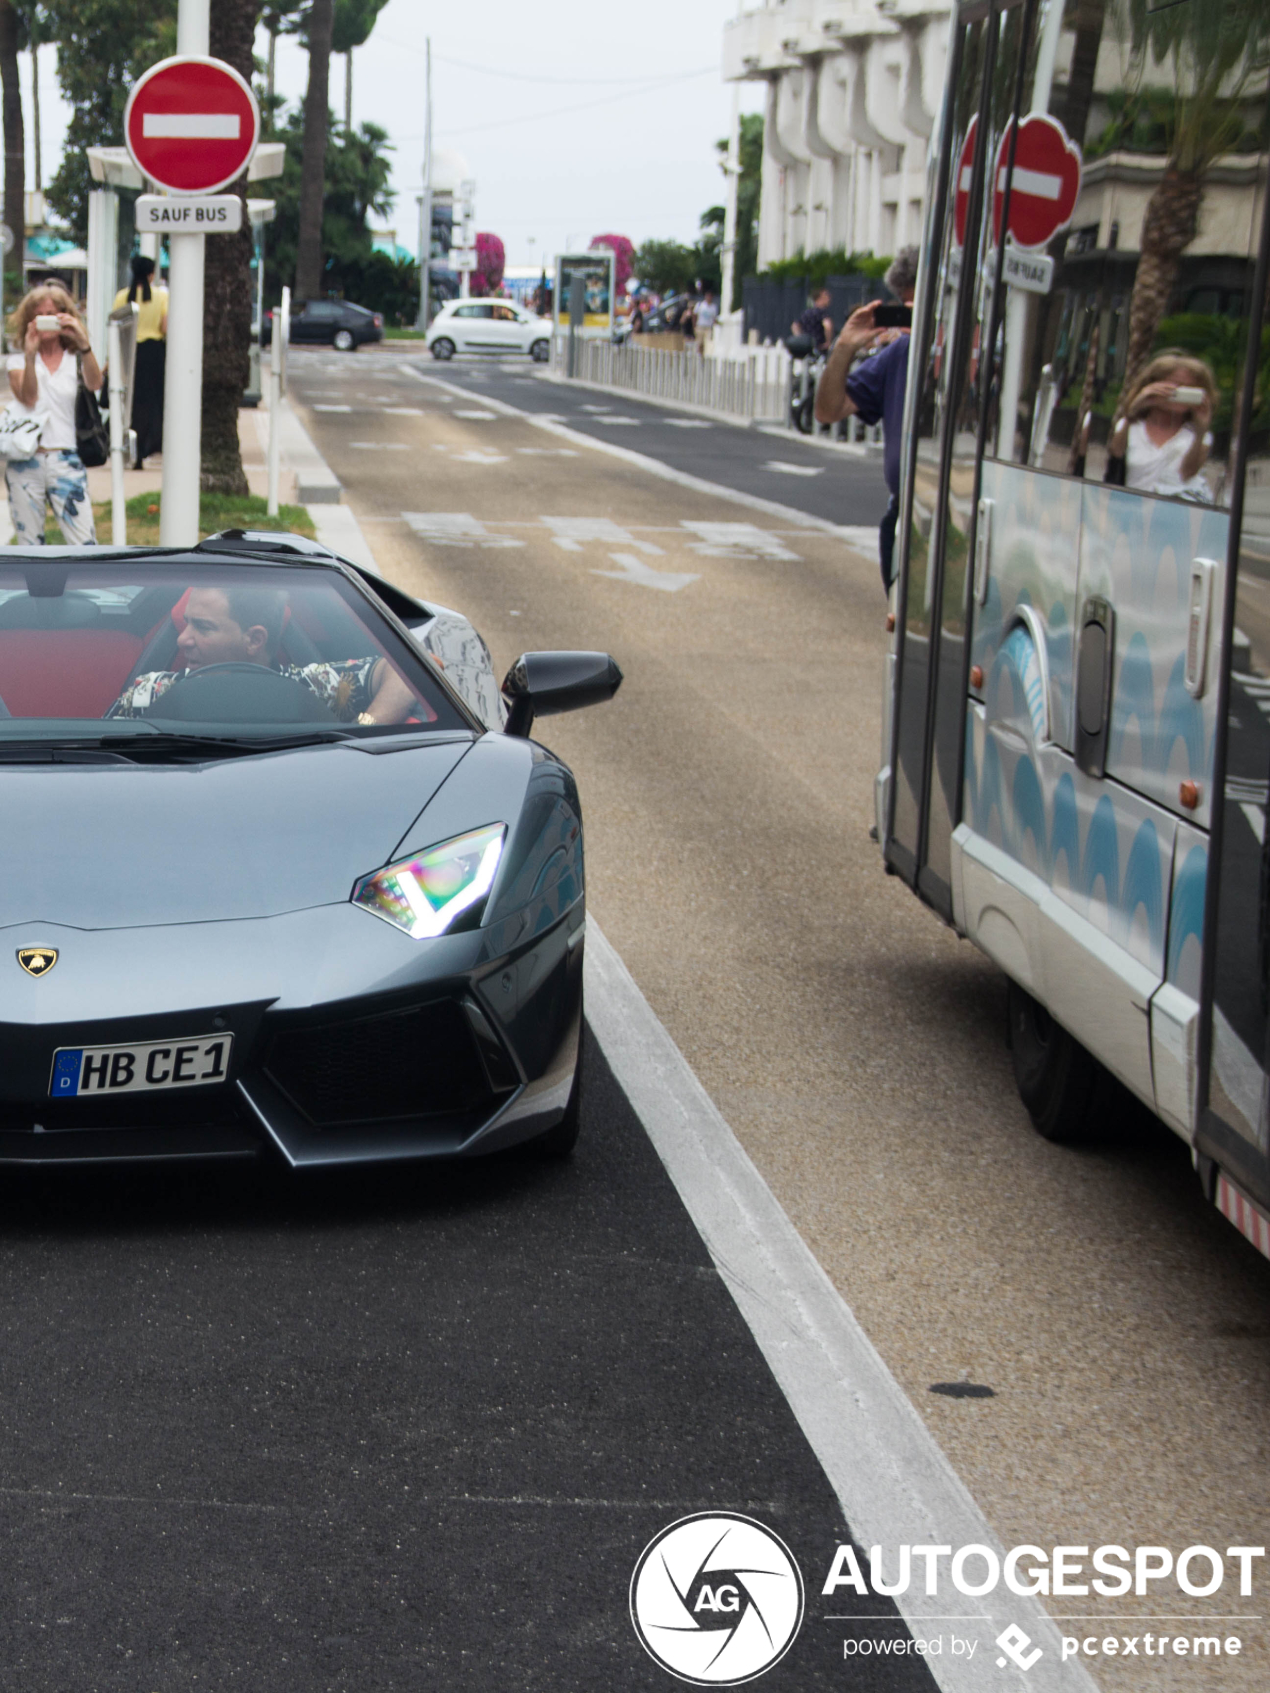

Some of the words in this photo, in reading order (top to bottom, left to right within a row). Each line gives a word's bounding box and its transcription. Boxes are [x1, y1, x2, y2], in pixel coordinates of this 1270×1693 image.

[150, 207, 192, 222] SAUF
[196, 207, 228, 222] BUS
[80, 1052, 136, 1090] HB
[145, 1042, 224, 1084] CE1
[60, 1077, 71, 1088] D
